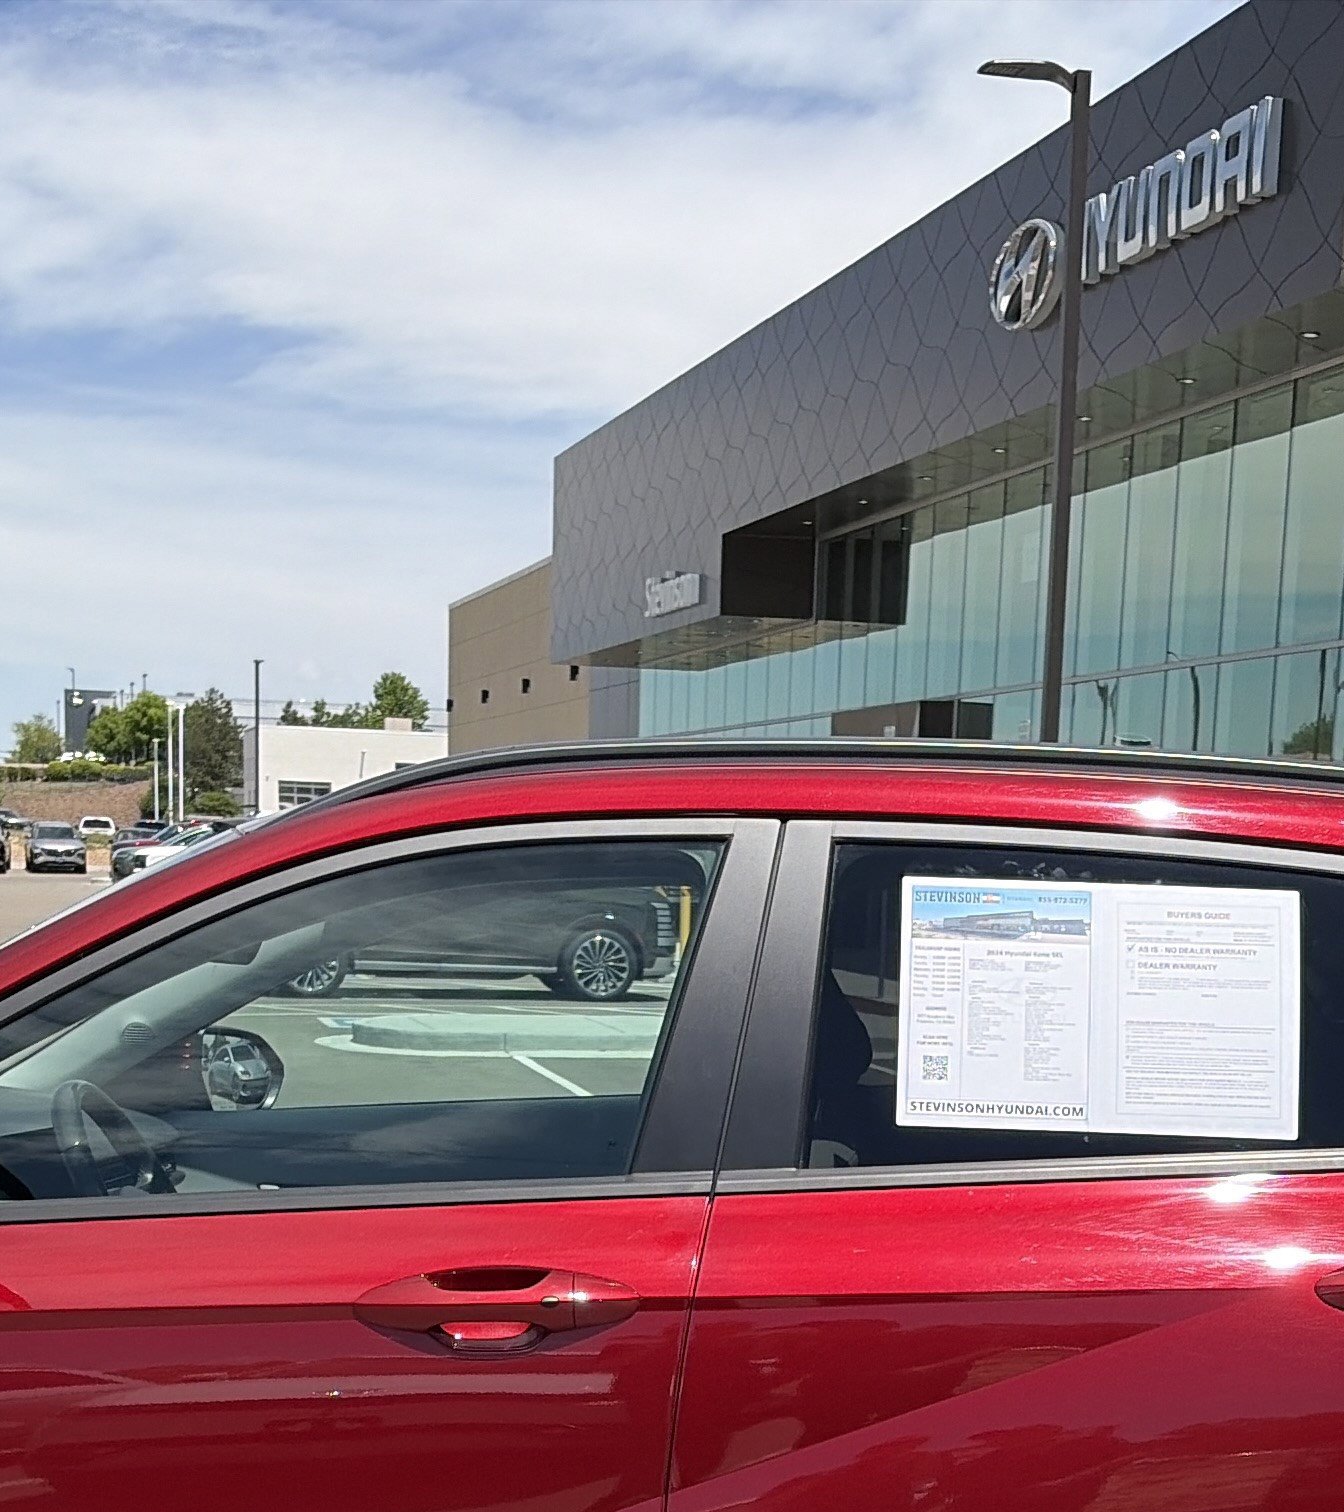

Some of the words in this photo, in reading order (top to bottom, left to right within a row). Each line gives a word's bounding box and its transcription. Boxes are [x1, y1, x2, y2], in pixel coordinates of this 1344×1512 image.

[915, 891, 981, 904] STEVINSON
[1167, 911, 1202, 919] BUYERS
[1204, 911, 1231, 920] GUIDE
[1178, 947, 1211, 955] DEALER
[1137, 961, 1170, 969] DEALER
[909, 1101, 1085, 1117] STEVINSONHYUNDAI.COM
